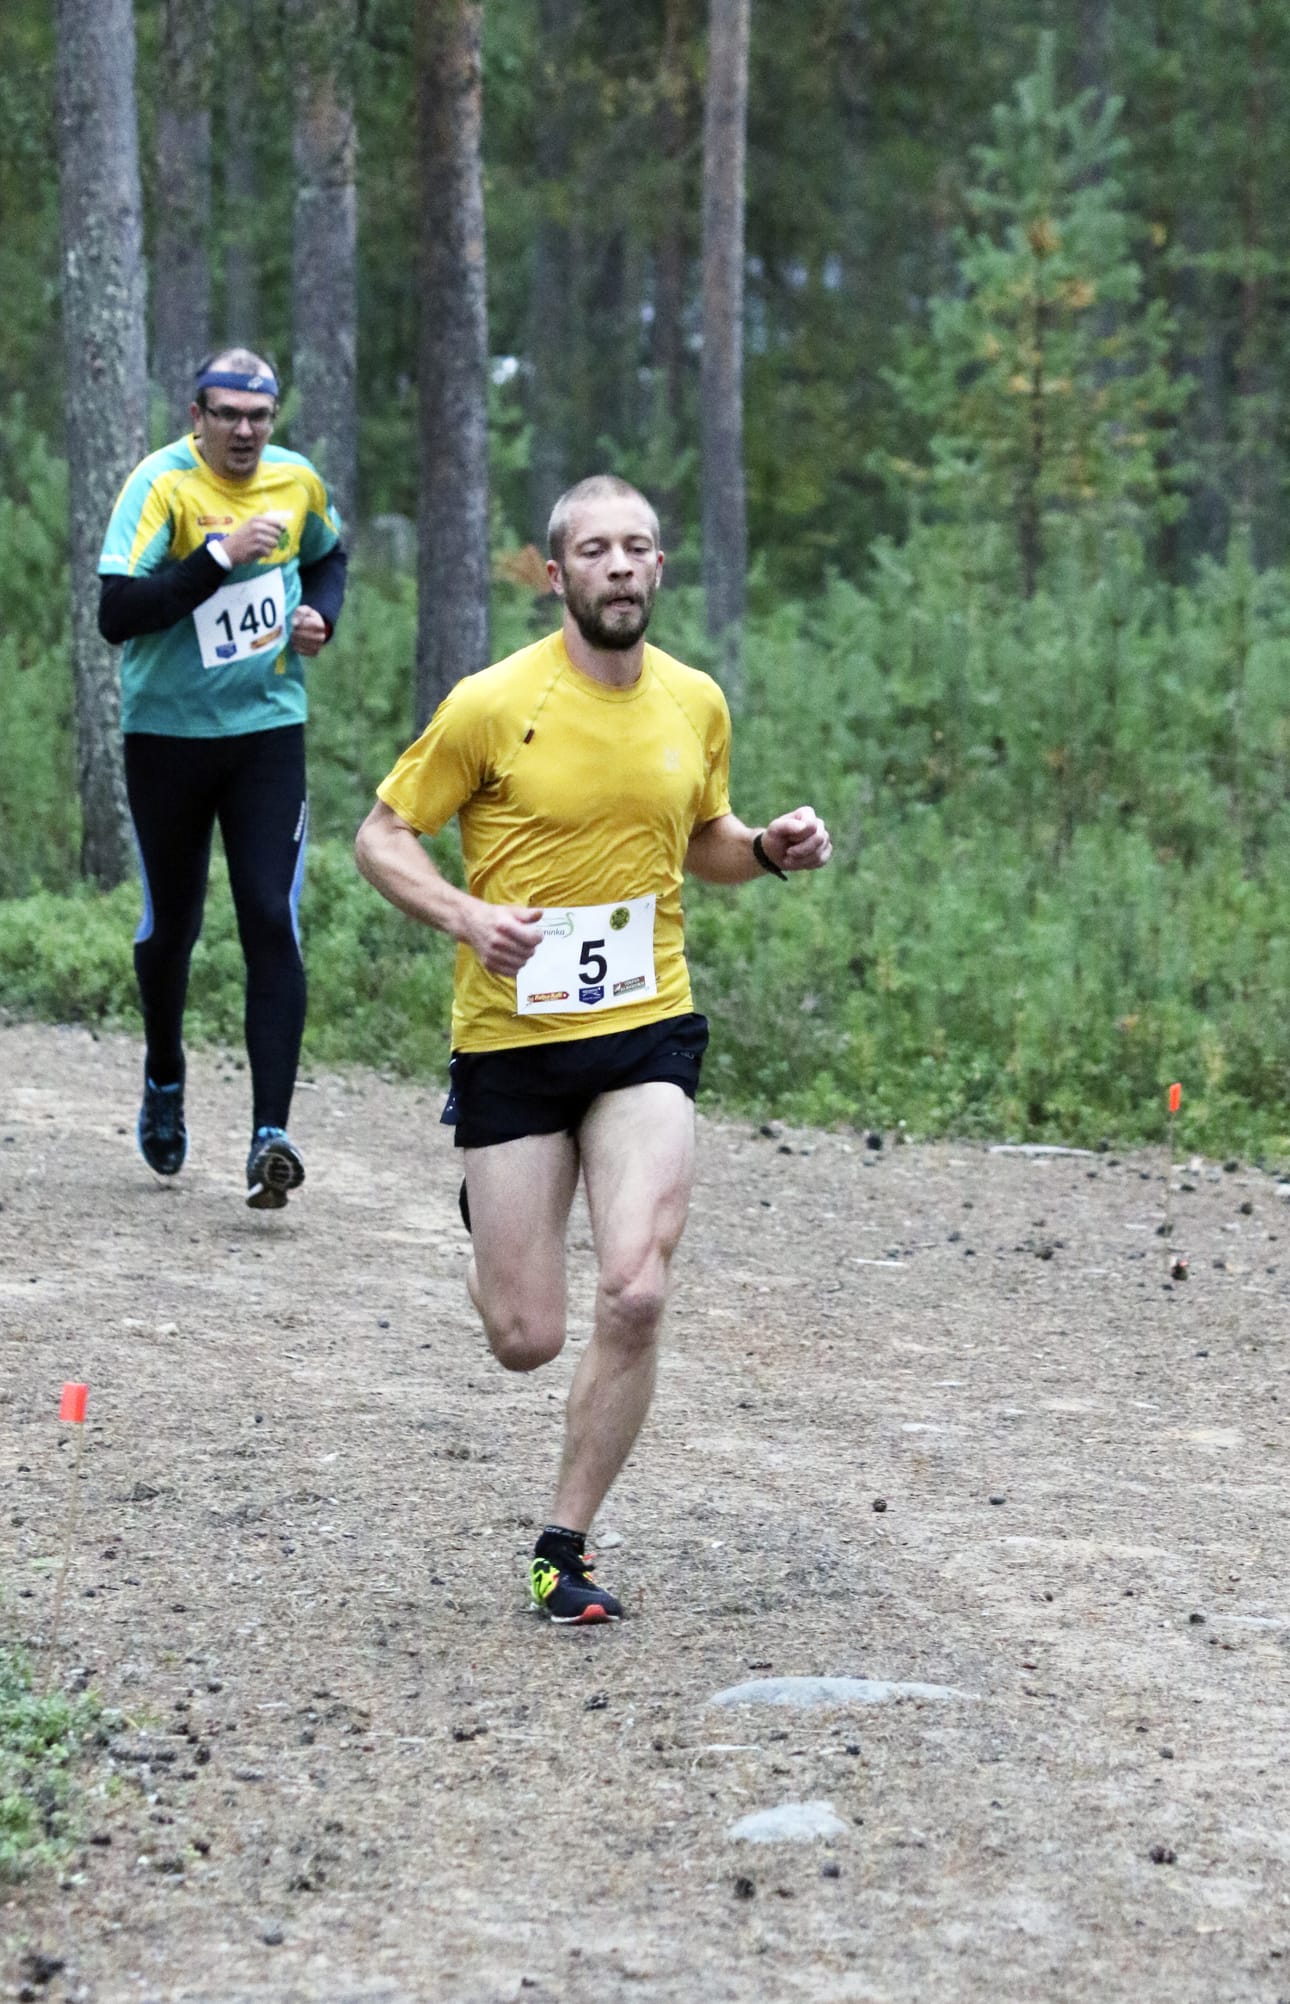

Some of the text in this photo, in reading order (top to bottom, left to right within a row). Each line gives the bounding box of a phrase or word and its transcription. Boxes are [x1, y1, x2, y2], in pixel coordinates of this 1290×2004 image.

[215, 597, 277, 641] 140
[543, 928, 566, 936] ninka
[578, 938, 608, 985] 5
